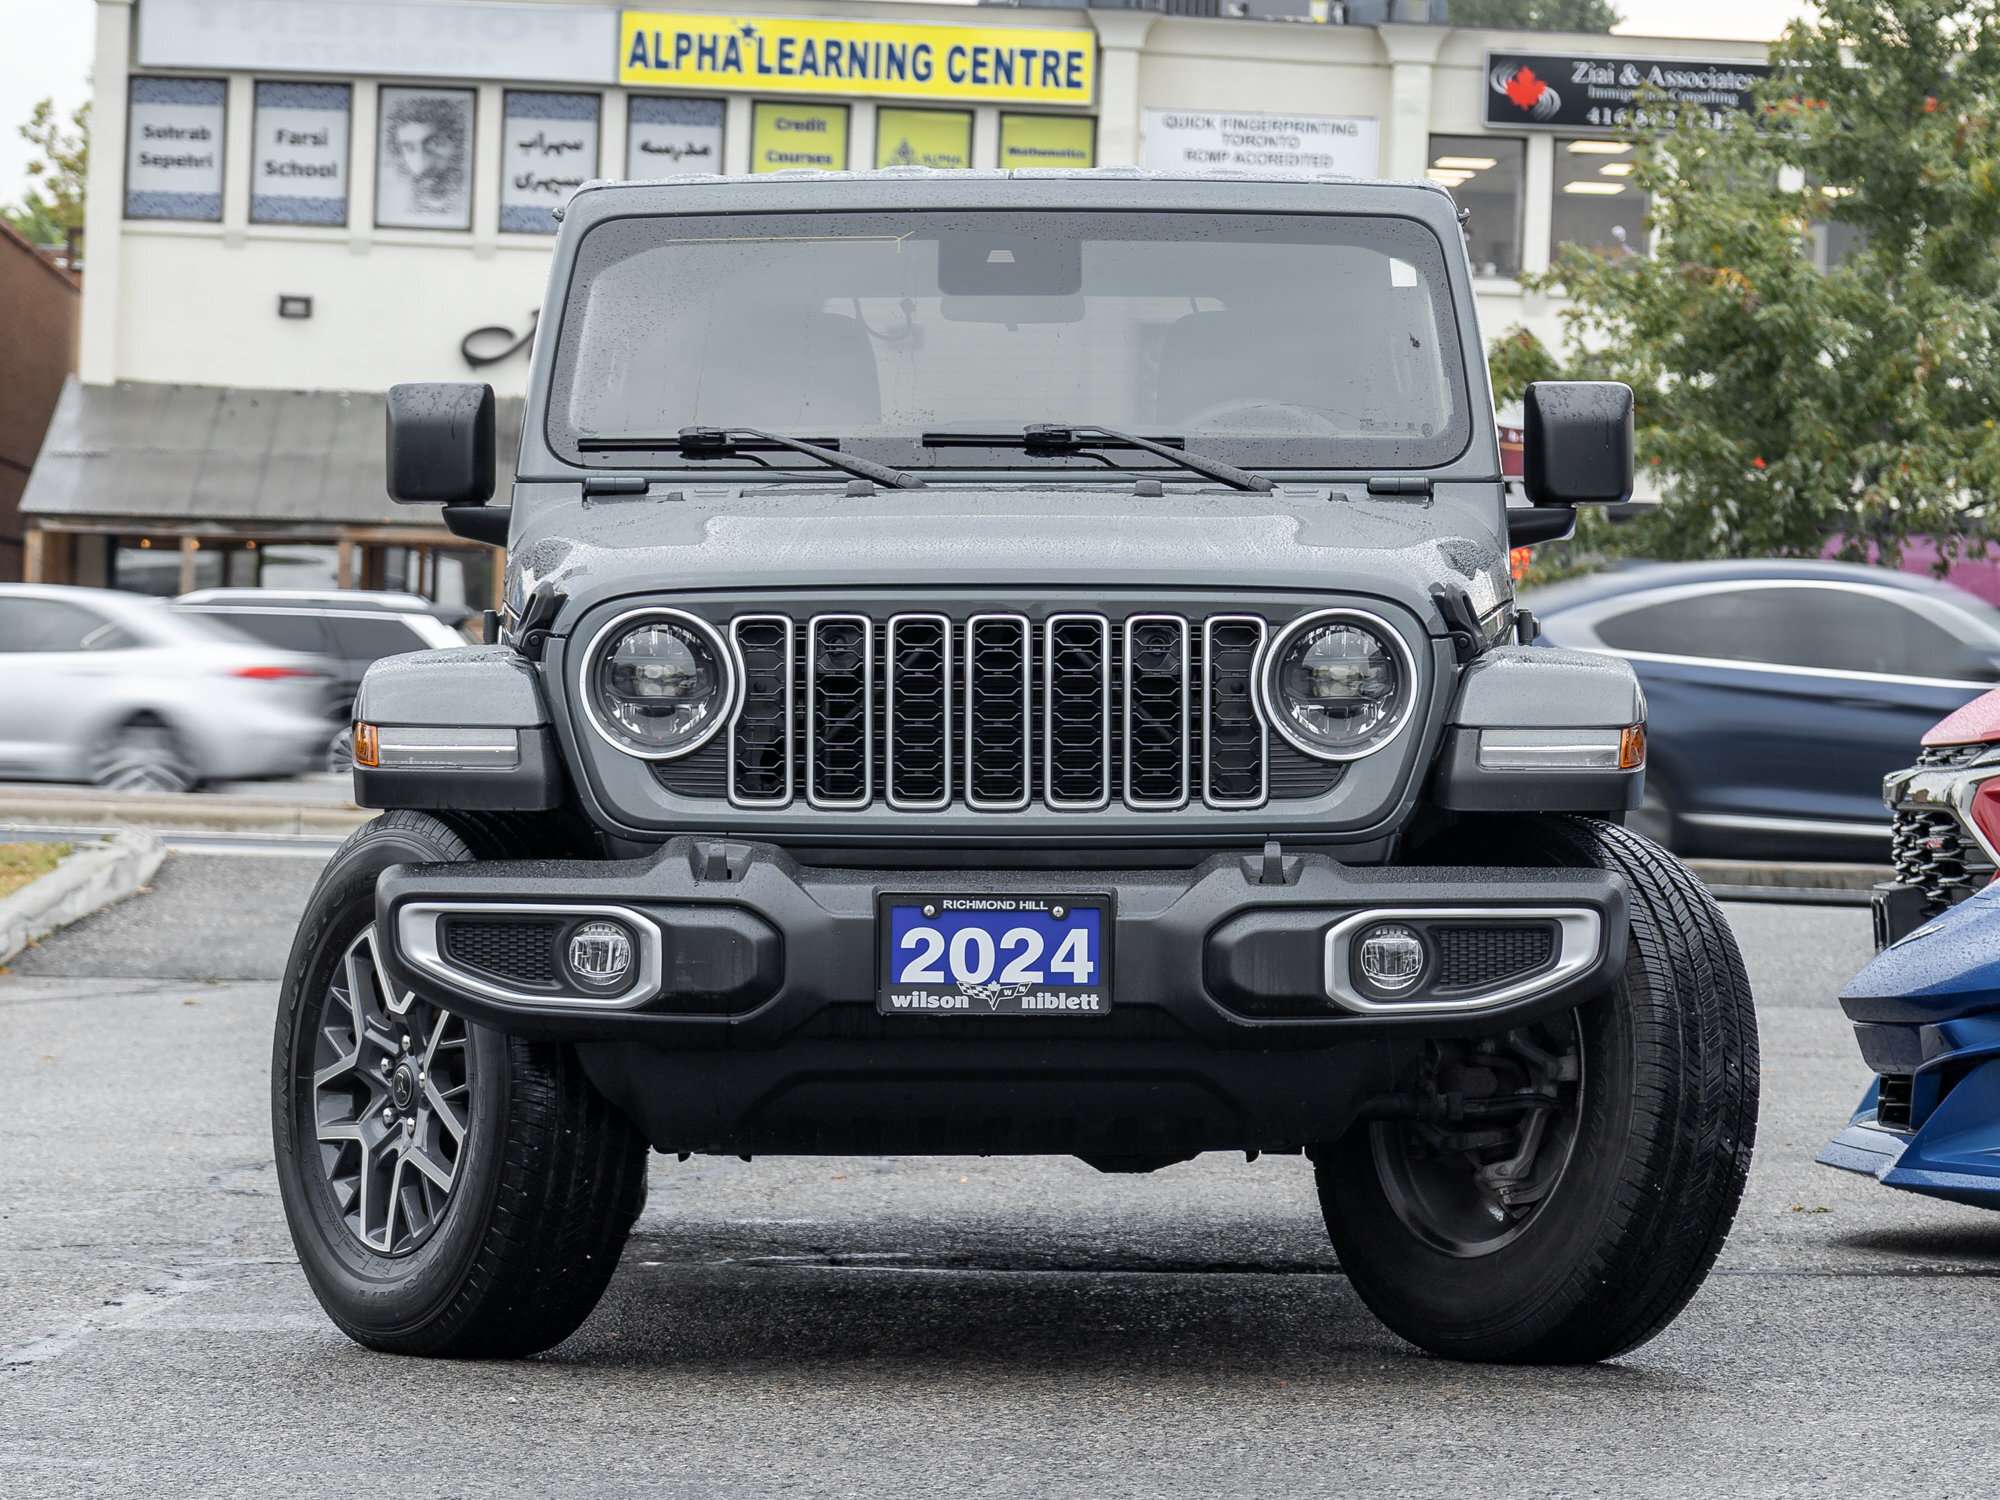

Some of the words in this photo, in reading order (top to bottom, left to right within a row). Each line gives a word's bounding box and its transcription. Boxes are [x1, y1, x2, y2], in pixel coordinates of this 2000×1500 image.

[628, 30, 742, 73] ALPHA
[757, 36, 932, 82] LEARNING
[947, 45, 1083, 88] CENTRE
[1619, 63, 1642, 86] &
[143, 124, 212, 141] Sohrab
[775, 116, 827, 132] Credit
[1163, 115, 1216, 130] QUICK
[1221, 117, 1359, 136] FINGERPRINTING
[275, 127, 329, 146] Farsi
[1222, 134, 1301, 149] TORONTO
[765, 149, 833, 165] Courses
[1233, 152, 1334, 168] ACCREDITED
[264, 158, 338, 178] School
[943, 899, 1017, 911] RICHMOND
[1019, 900, 1049, 911] HILL
[900, 926, 1094, 984] 2024
[890, 991, 970, 1009] wilson
[1021, 992, 1100, 1010] niblett
